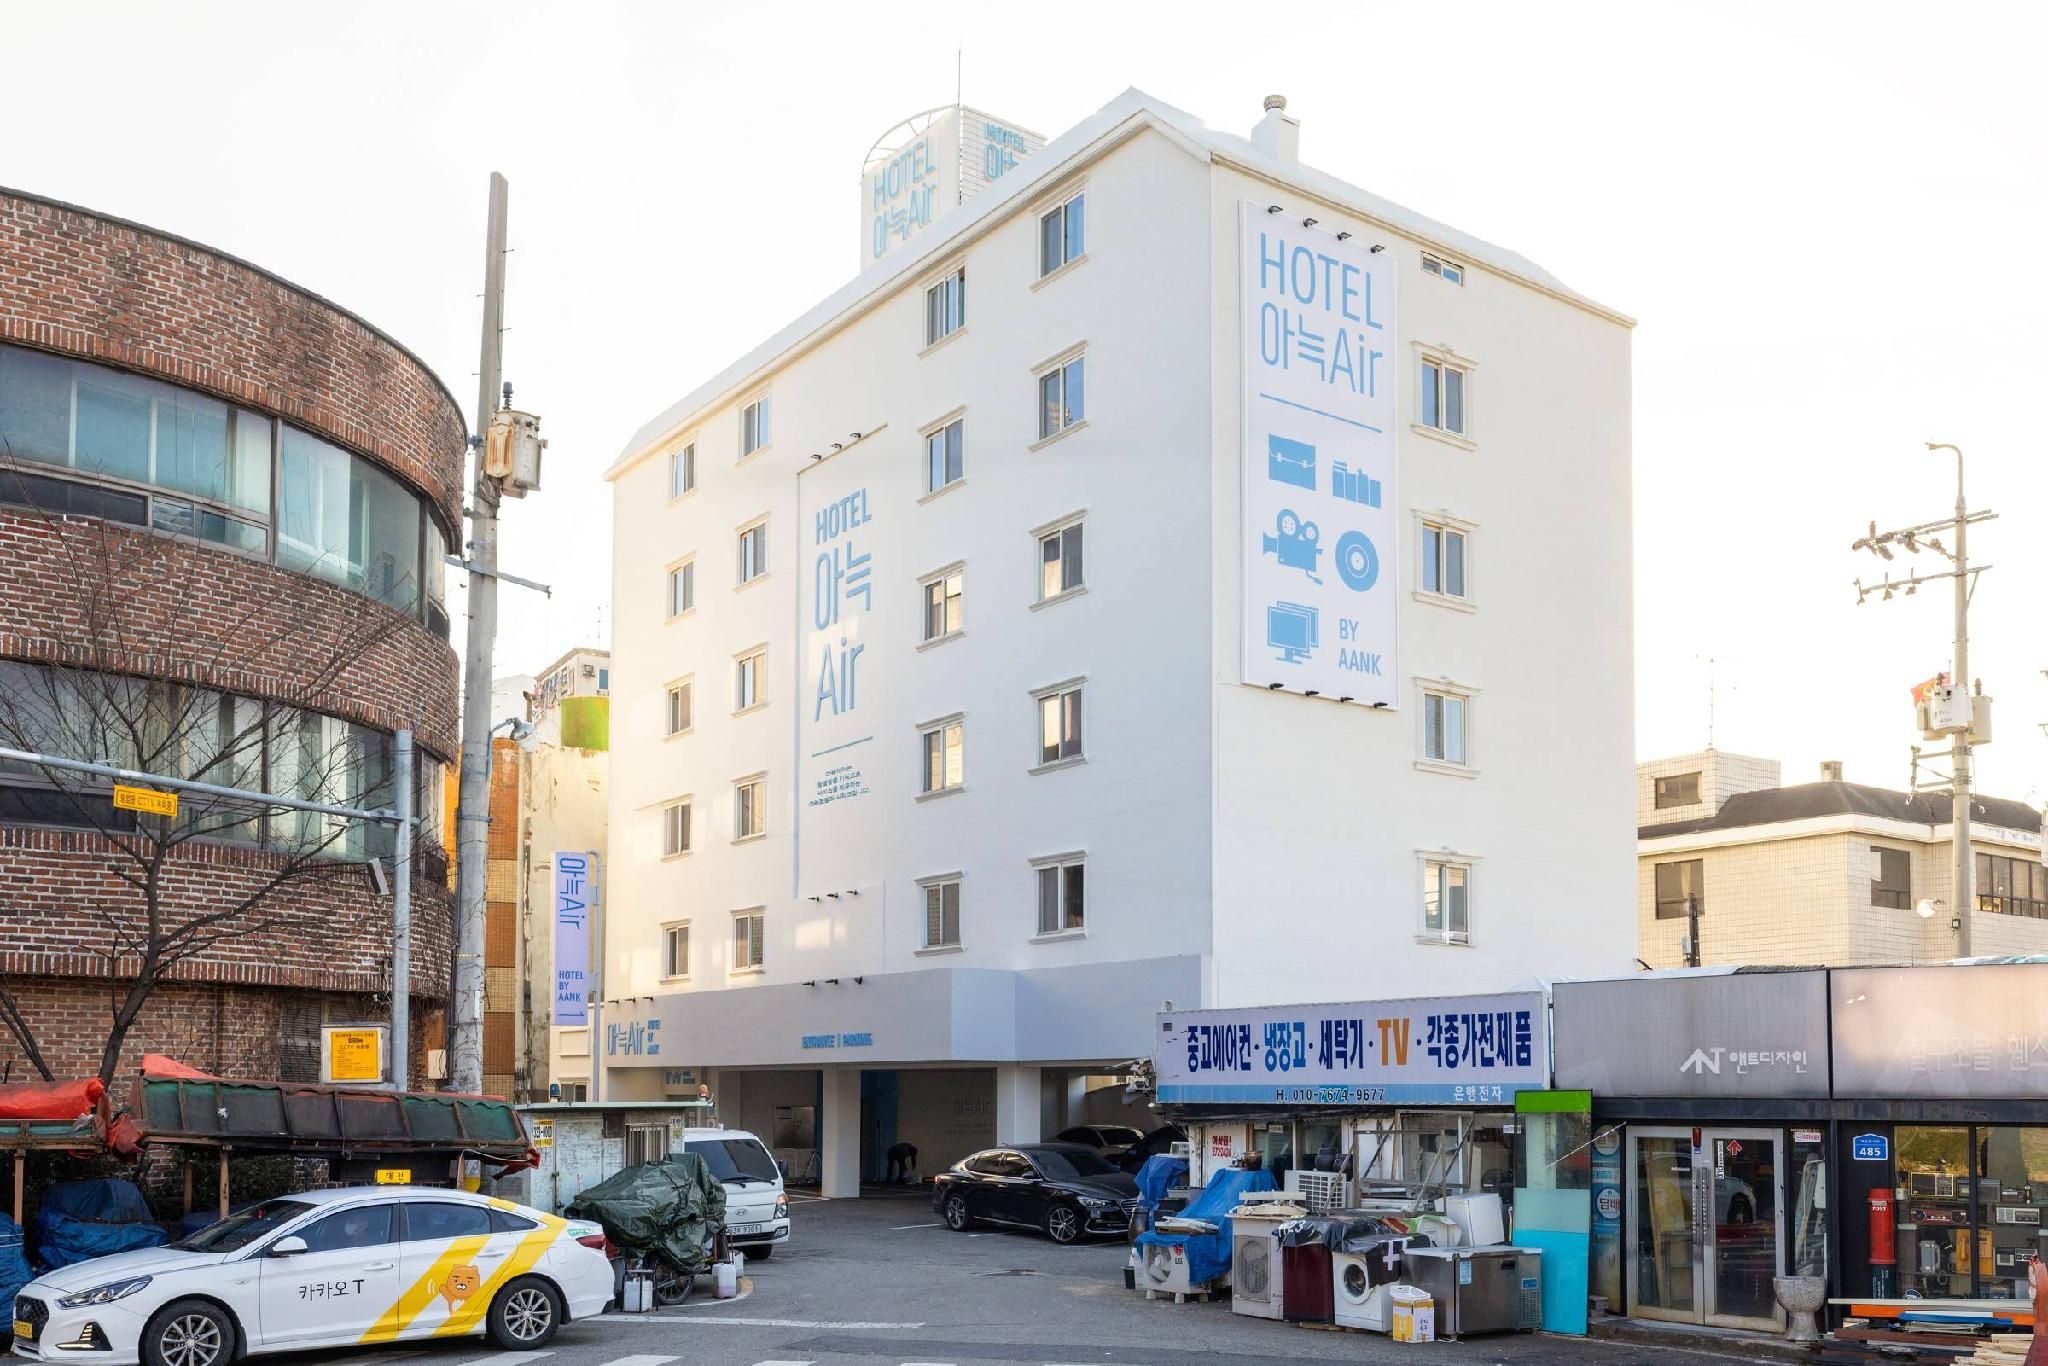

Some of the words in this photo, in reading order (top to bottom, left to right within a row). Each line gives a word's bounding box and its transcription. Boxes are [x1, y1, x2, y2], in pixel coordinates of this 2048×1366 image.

[874, 136, 936, 210] HOTEL
[1260, 232, 1383, 330] HOTEL
[815, 487, 872, 545] HOTEL
[1339, 618, 1359, 642] BY
[1338, 647, 1382, 676] AANK
[814, 637, 864, 722] Air
[559, 970, 584, 980] HOTEL
[559, 981, 569, 991] BY
[558, 992, 581, 1002] AANK
[1377, 1018, 1410, 1066] TV
[1729, 1050, 1807, 1074] 앤트디자인
[1454, 1085, 1503, 1102] 은행전자
[1859, 1147, 1881, 1156] 485
[352, 1279, 365, 1294] T
